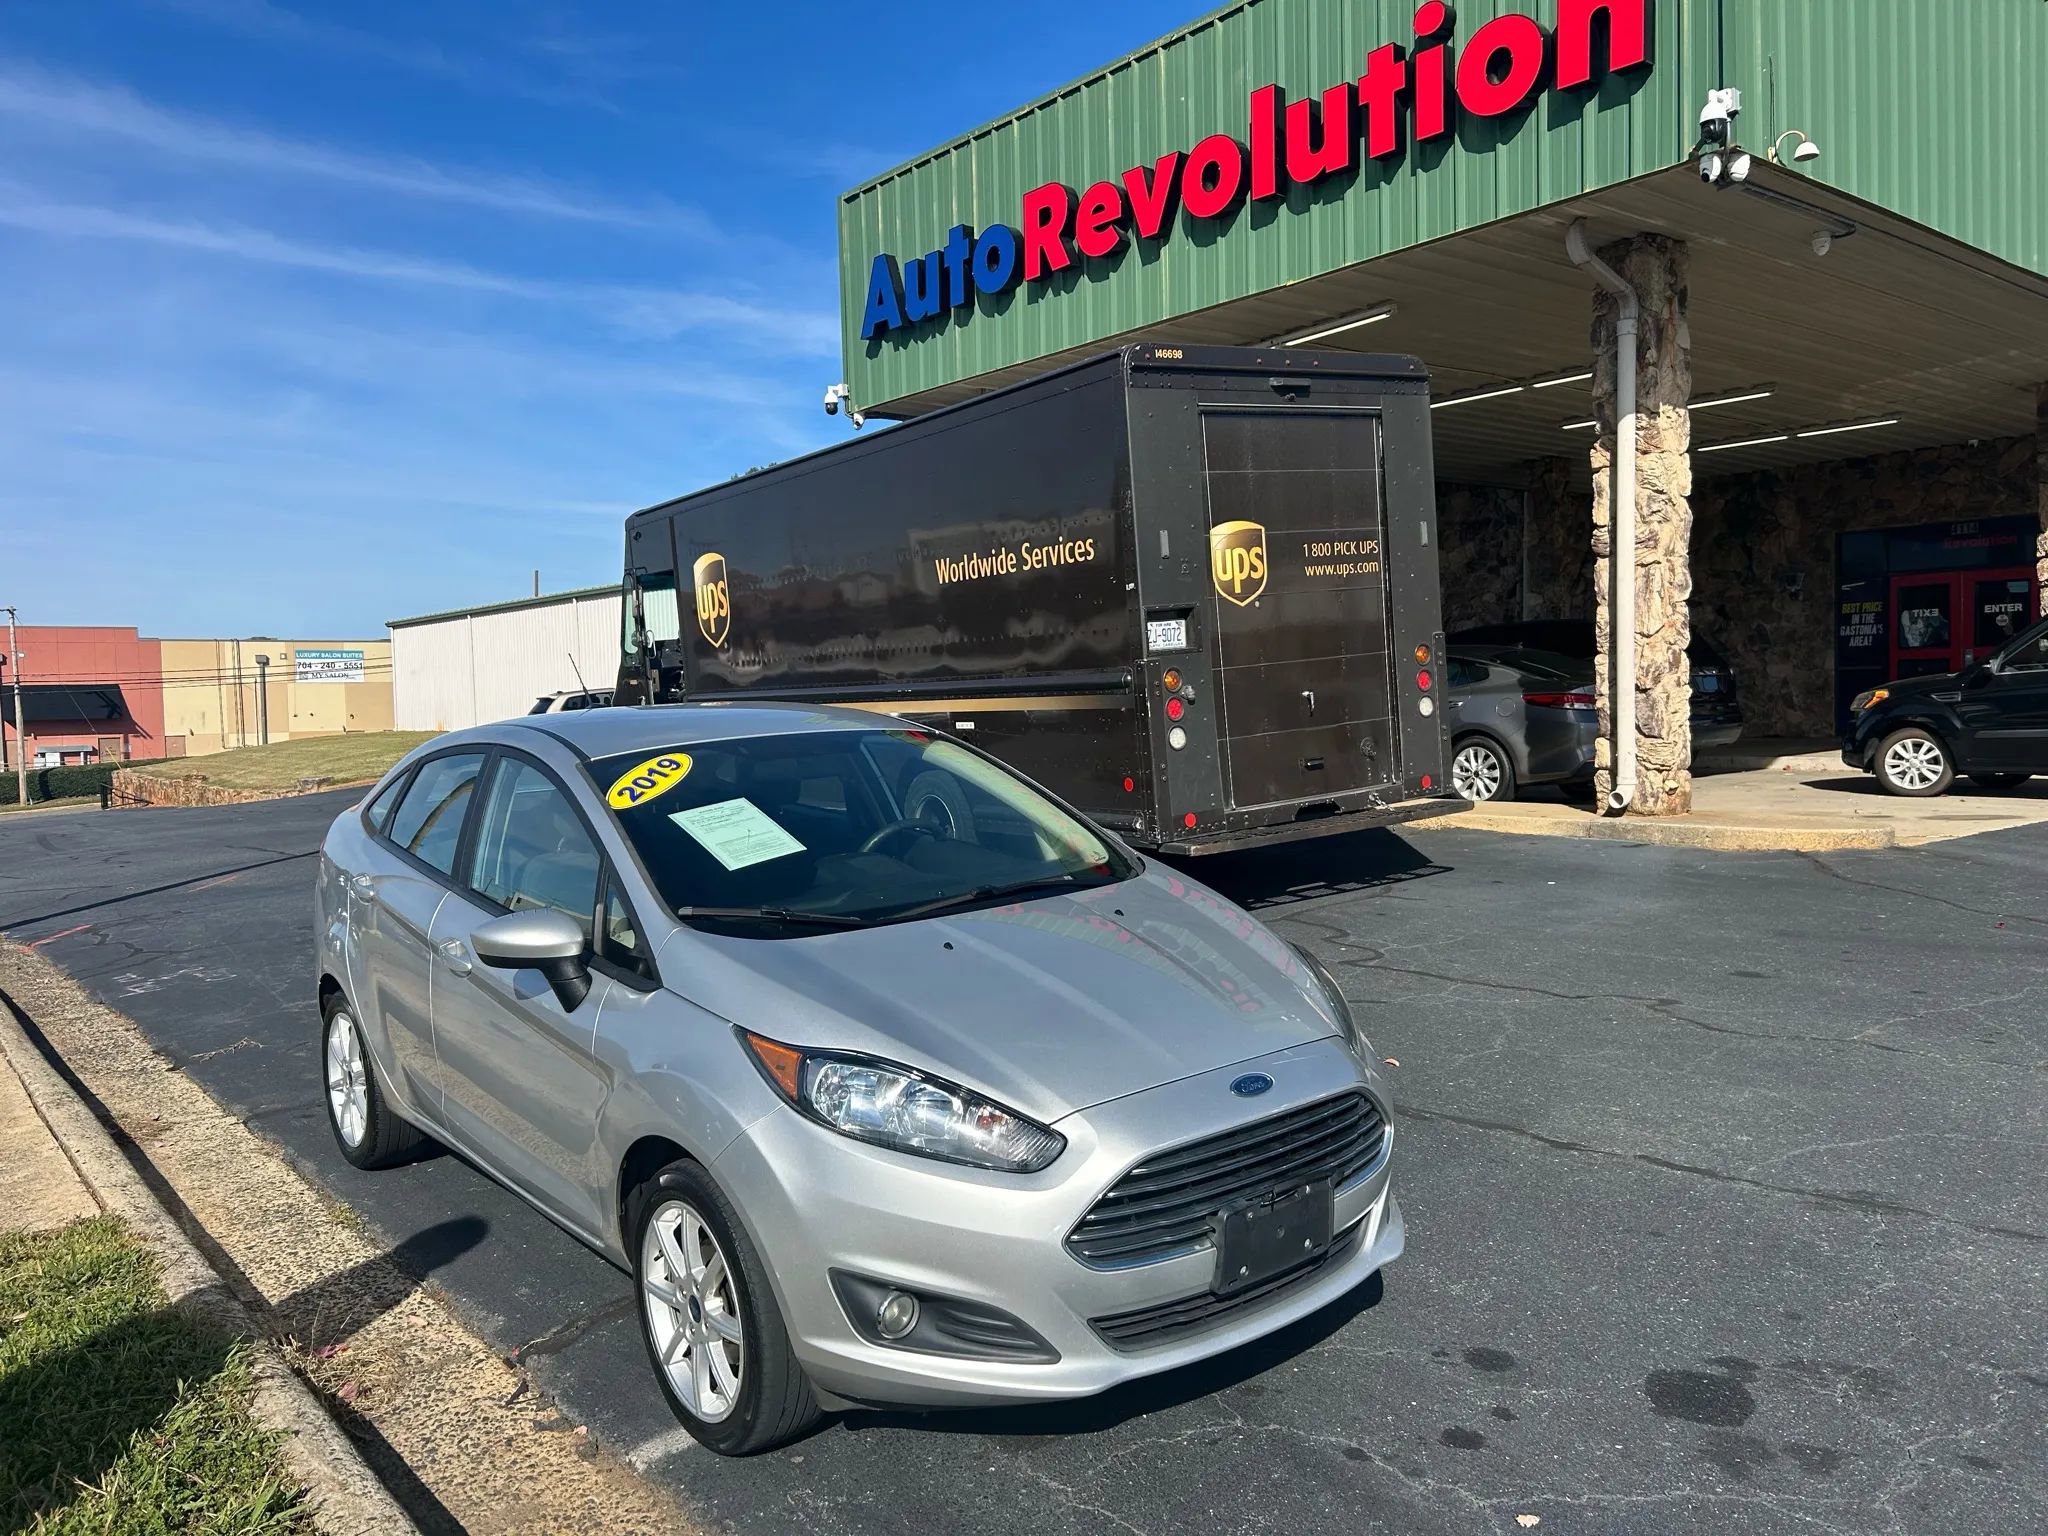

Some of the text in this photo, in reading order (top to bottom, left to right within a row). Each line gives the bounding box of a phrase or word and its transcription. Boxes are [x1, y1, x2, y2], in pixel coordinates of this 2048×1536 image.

[1155, 349, 1183, 359] 146698
[1303, 540, 1379, 557] 1 800 PICK UPS
[935, 535, 1095, 584] Worldwide Services
[1215, 546, 1264, 594] ups
[1304, 561, 1379, 578] www.ups.com
[698, 580, 728, 634] ups
[1841, 601, 1883, 614] BEST PRICE
[1984, 603, 2023, 613] ENTER
[1851, 613, 1876, 624] IN THE
[1849, 636, 1873, 647] AREA!
[344, 662, 363, 670] 5551
[617, 757, 681, 803] 2019
